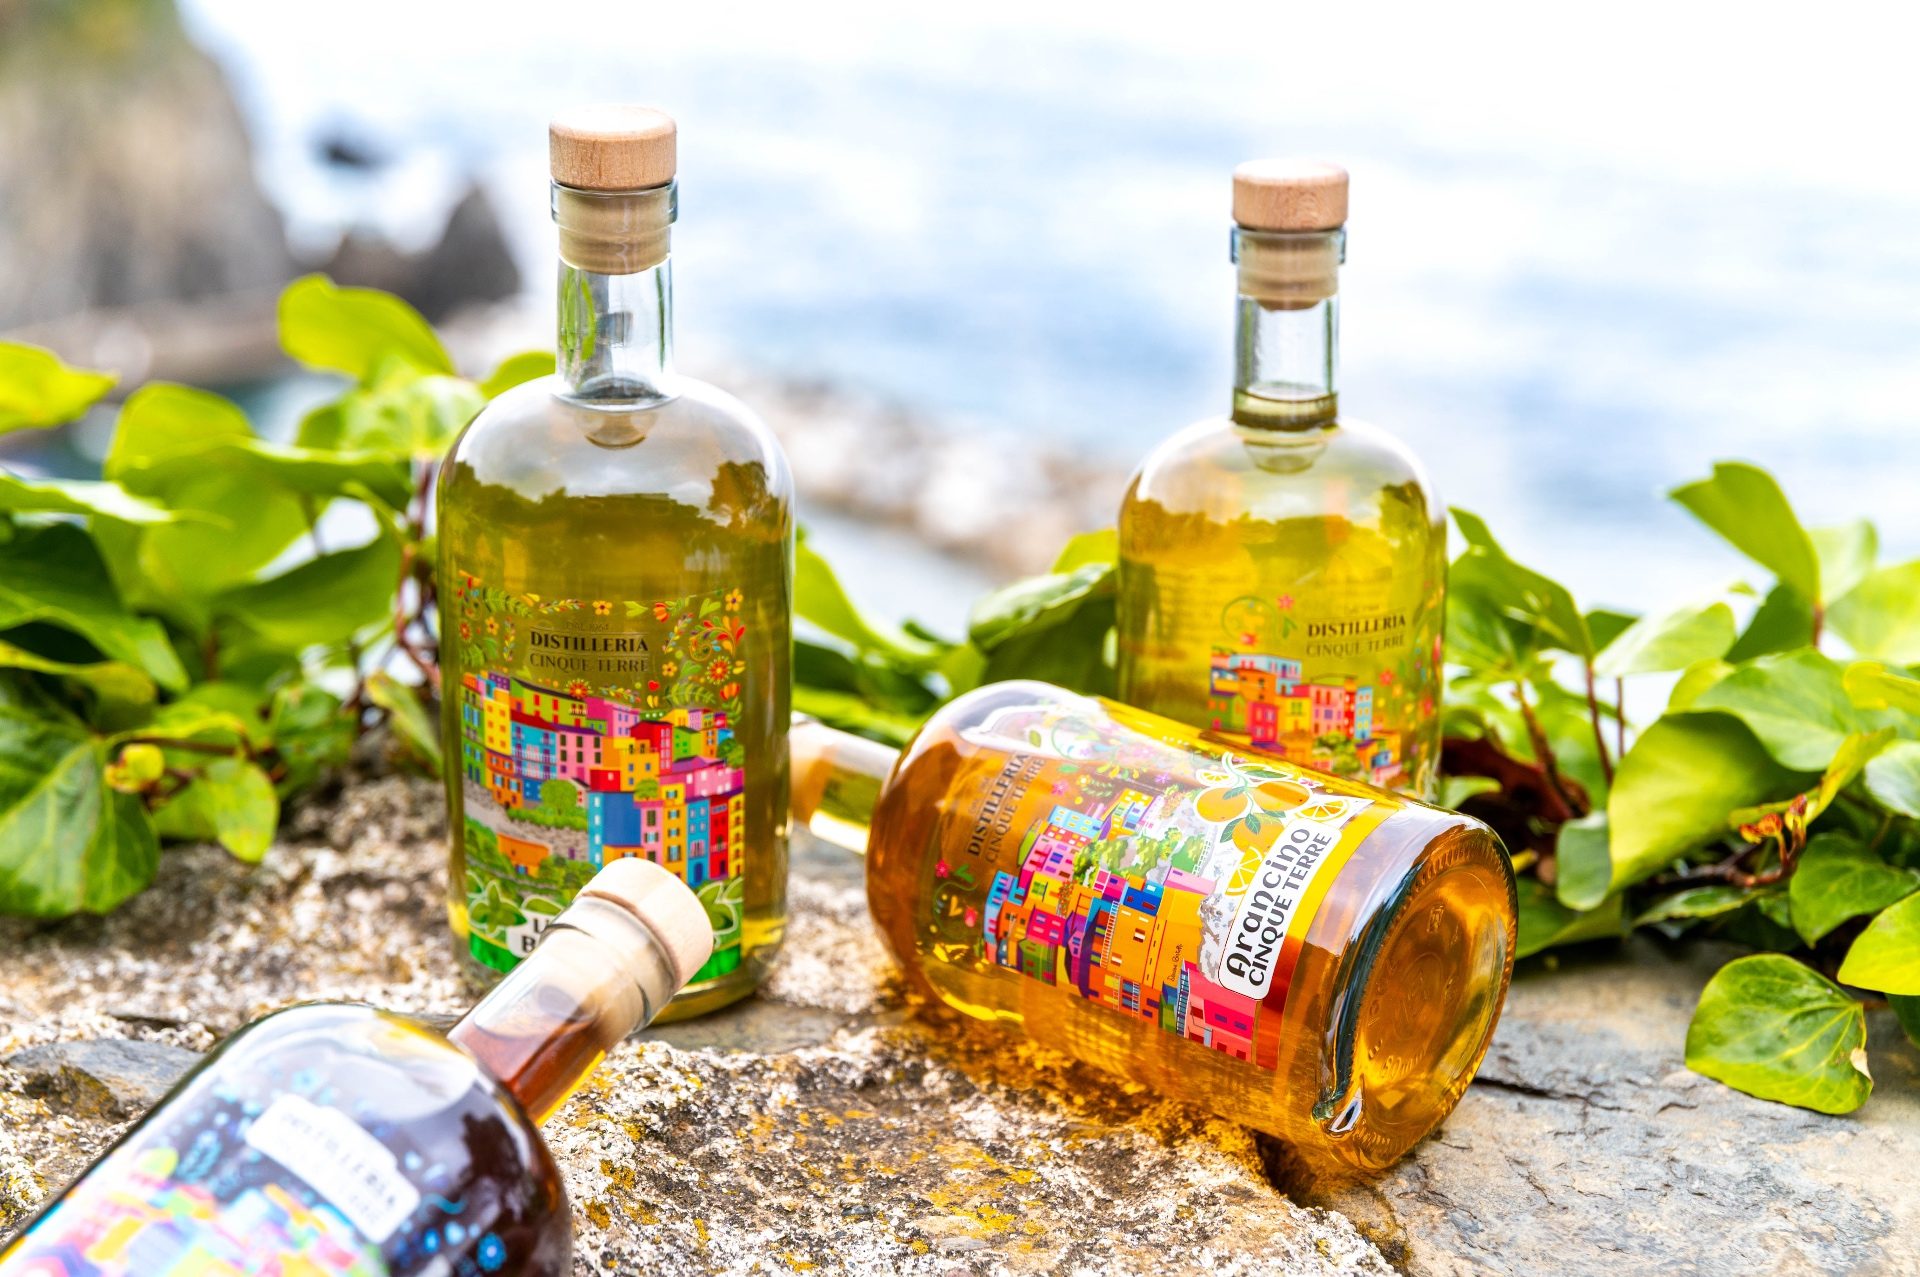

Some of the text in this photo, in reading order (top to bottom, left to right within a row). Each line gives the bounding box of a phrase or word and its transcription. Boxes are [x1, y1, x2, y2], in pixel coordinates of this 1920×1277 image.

[530, 631, 649, 652] DISTILLERIA
[1306, 635, 1405, 659] CINQUE TERRE
[1308, 615, 1406, 637] DISTILLERIA
[529, 653, 649, 673] CINQUE TERRE
[968, 754, 1030, 857] DISTILLERIA
[985, 759, 1047, 864] CINQUE TERRE
[1226, 828, 1310, 979] Arancino
[1249, 833, 1332, 987] CINQUE TERRE
